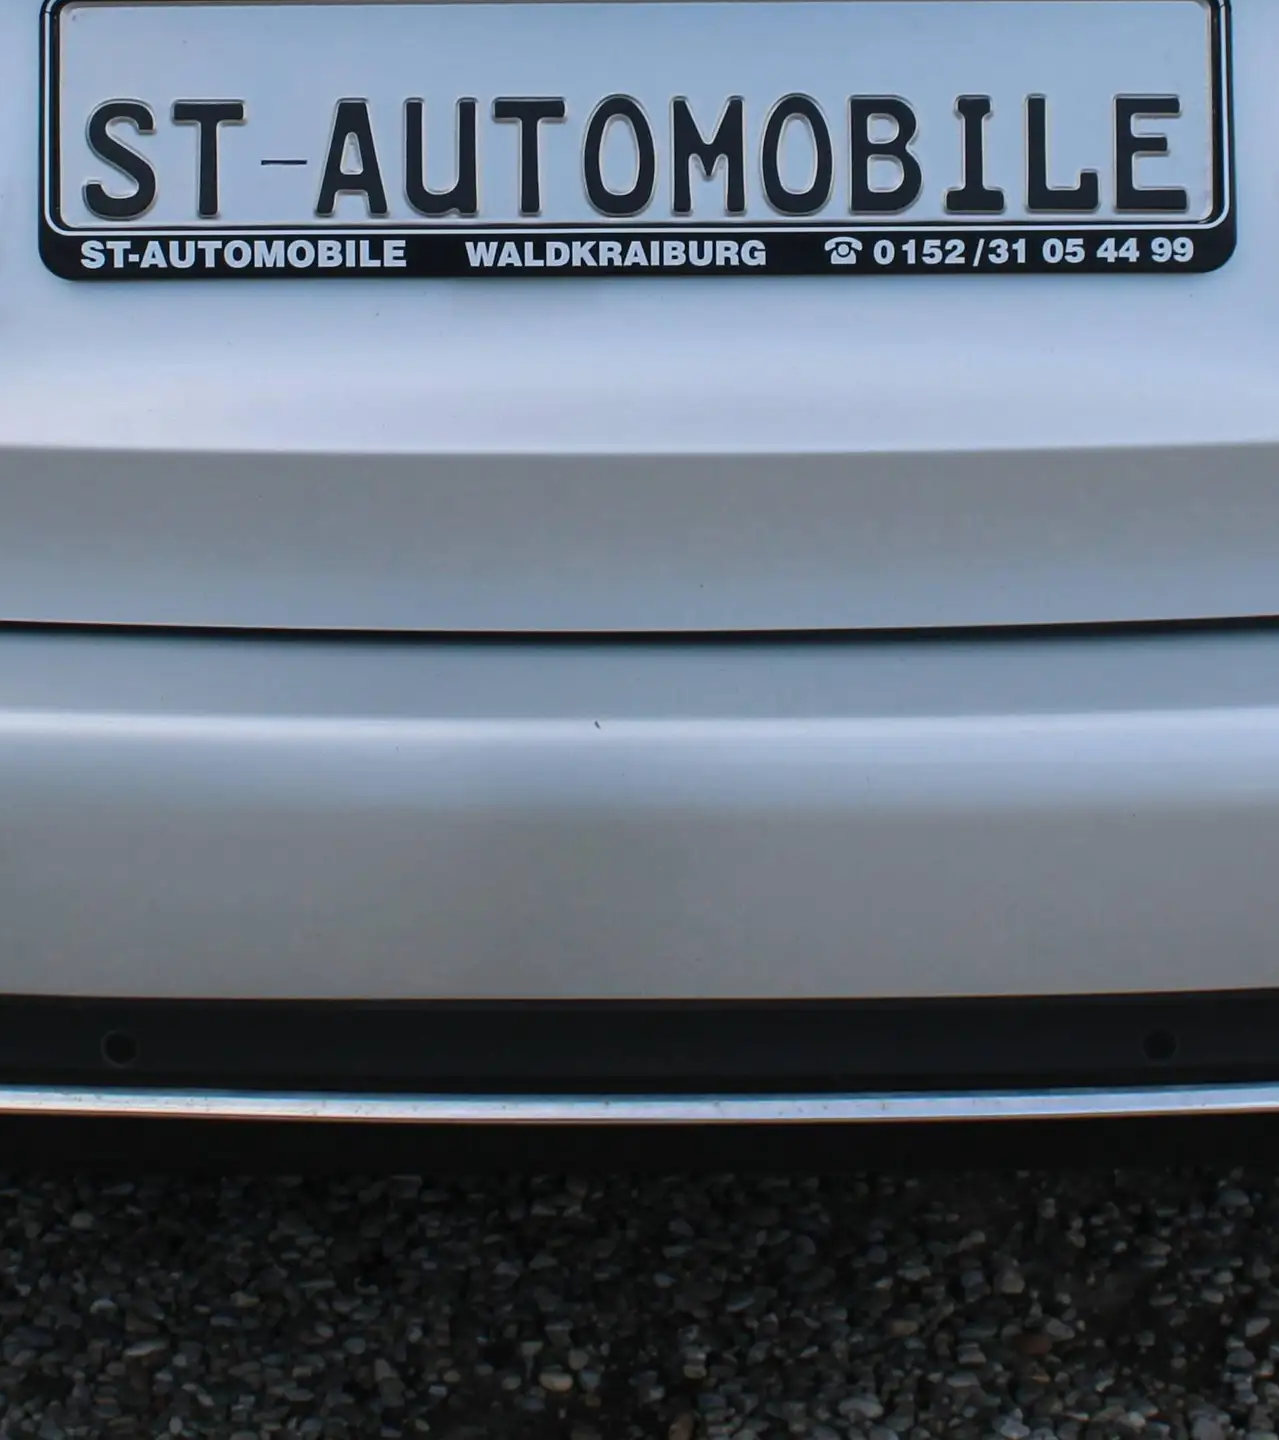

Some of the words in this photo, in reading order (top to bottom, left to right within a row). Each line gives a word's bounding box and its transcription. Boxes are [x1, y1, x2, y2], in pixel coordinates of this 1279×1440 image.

[81, 94, 1188, 217] ST-AUTOMOBILE
[80, 239, 407, 269] ST-AUTOMOBILE
[464, 239, 768, 267] WALDKRAIBURG
[1042, 237, 1085, 263] 05
[1096, 237, 1140, 263] 44
[1150, 236, 1195, 262] 99
